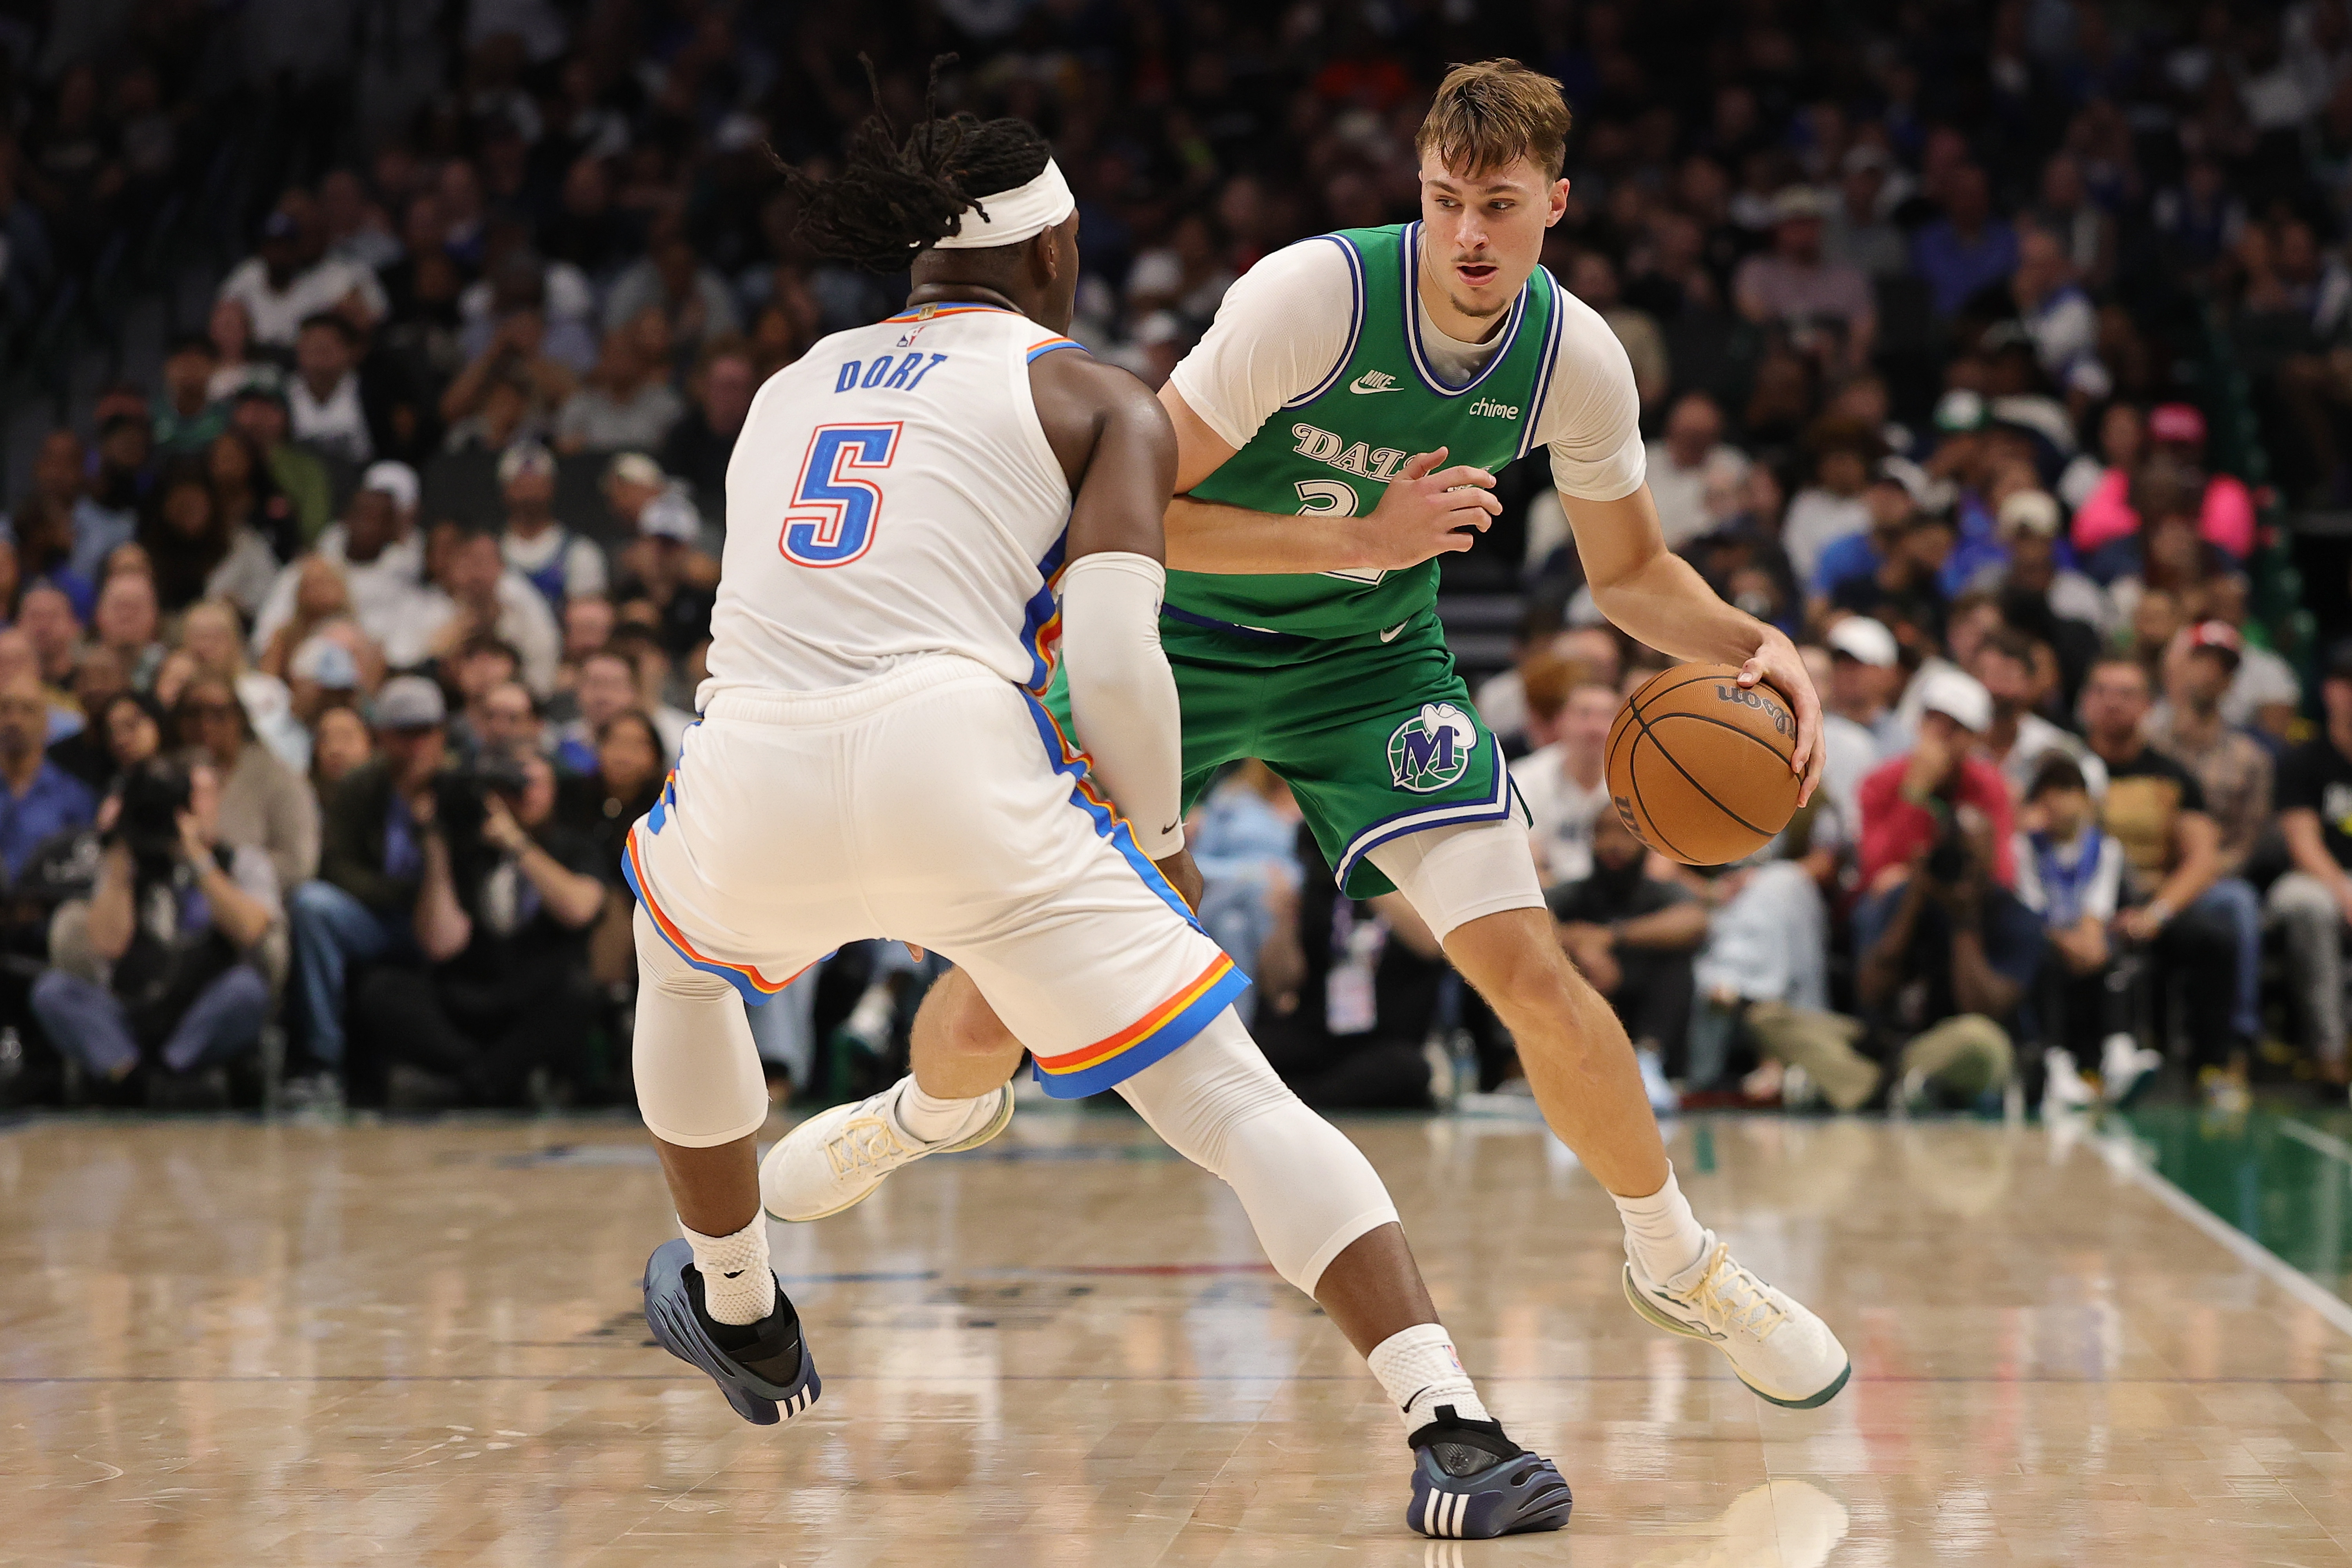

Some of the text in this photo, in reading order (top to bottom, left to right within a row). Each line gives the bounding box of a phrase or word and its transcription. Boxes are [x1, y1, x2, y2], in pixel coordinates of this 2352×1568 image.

[834, 352, 948, 393] DORT
[1360, 369, 1396, 389] NIKE
[1469, 397, 1519, 420] chime
[779, 421, 904, 568] 5
